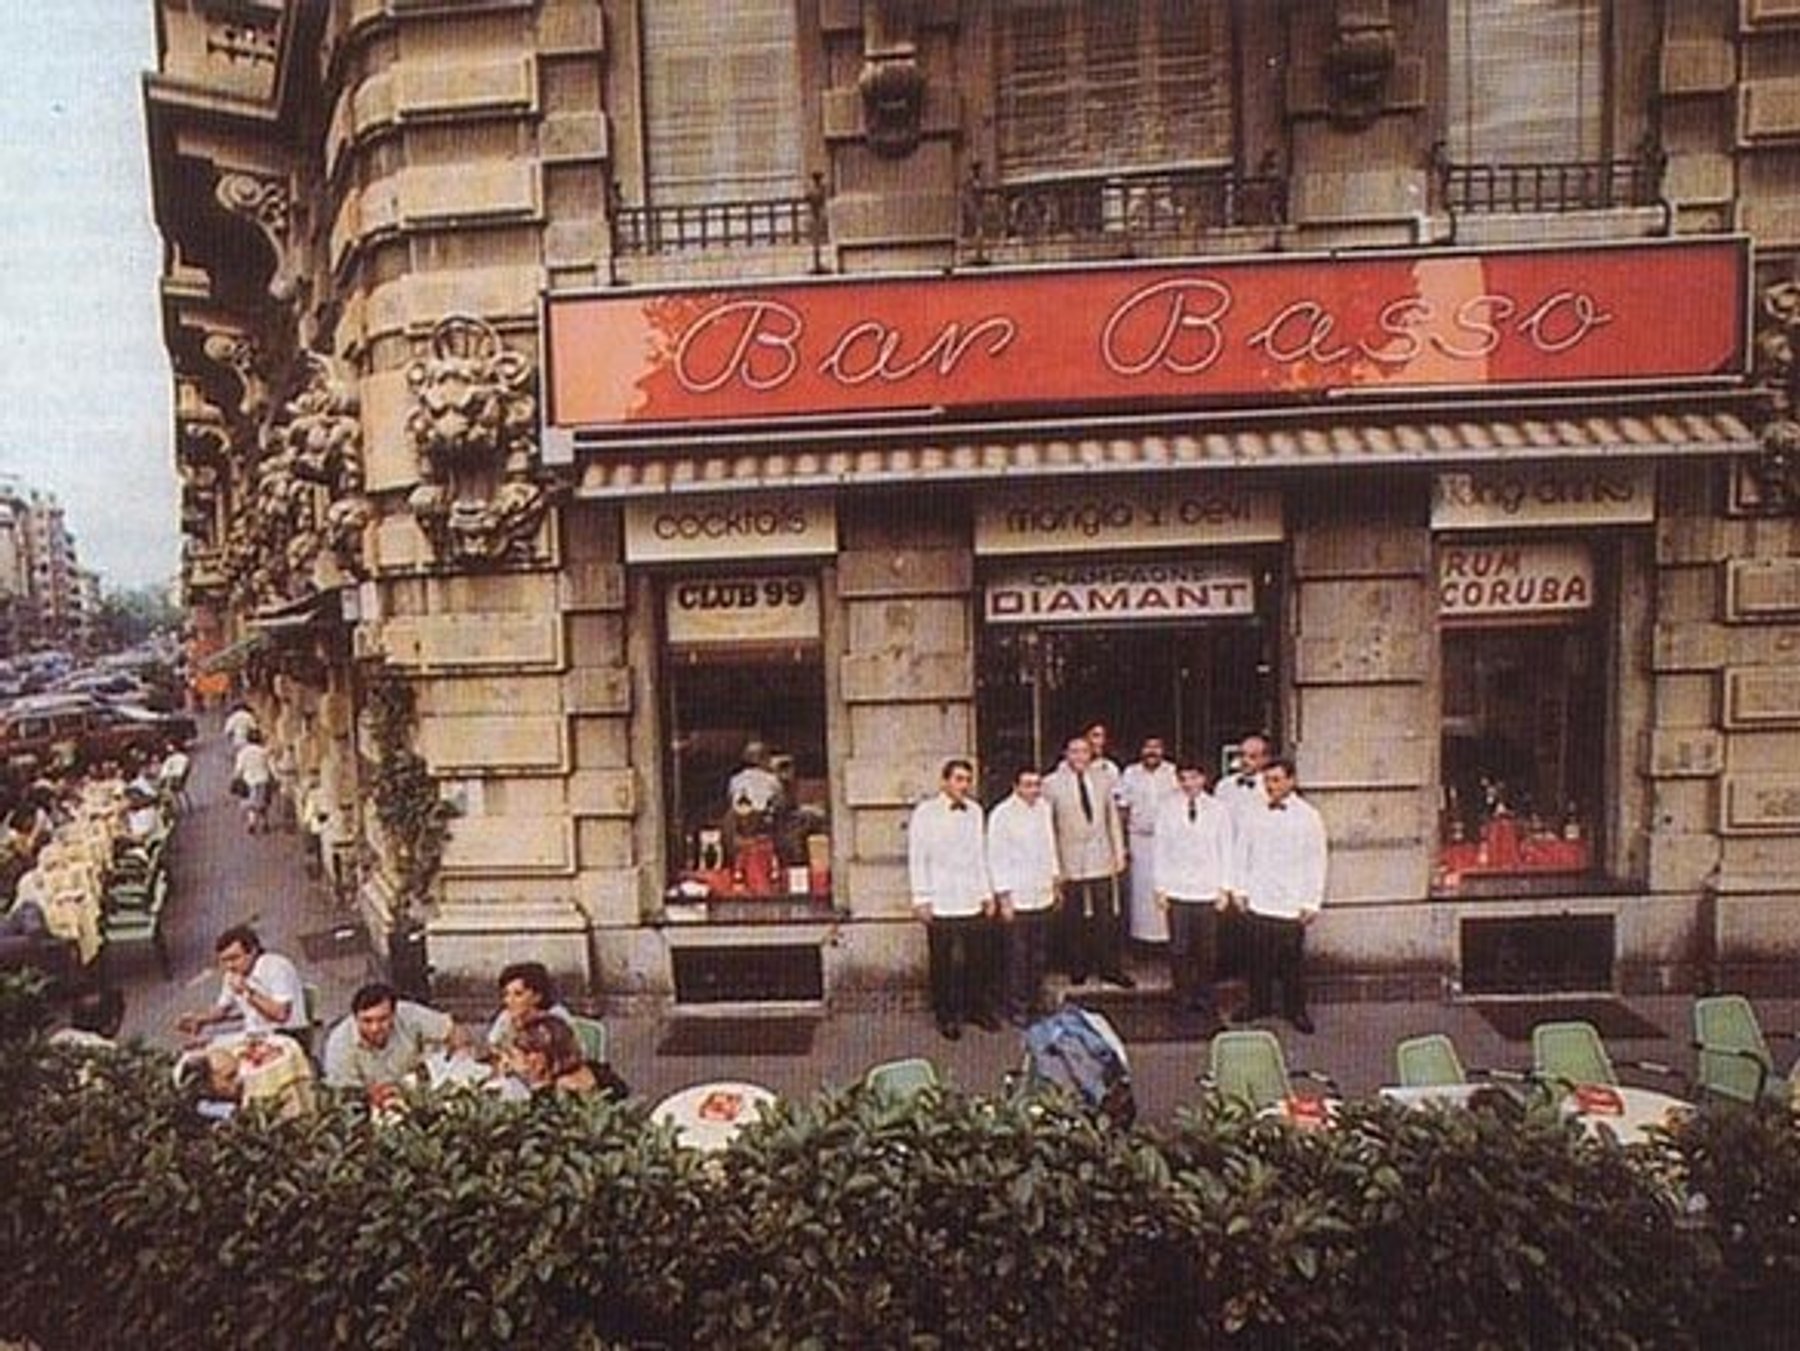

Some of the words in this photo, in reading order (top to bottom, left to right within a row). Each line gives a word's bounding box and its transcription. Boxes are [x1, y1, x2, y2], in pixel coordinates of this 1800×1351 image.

[673, 299, 1015, 393] Bar
[1101, 277, 1613, 376] Basso
[1446, 549, 1522, 577] RUM
[678, 582, 758, 610] CLUB
[764, 580, 804, 607] 99
[990, 580, 1248, 615] DIAMANT
[1440, 575, 1587, 607] CORUBA
